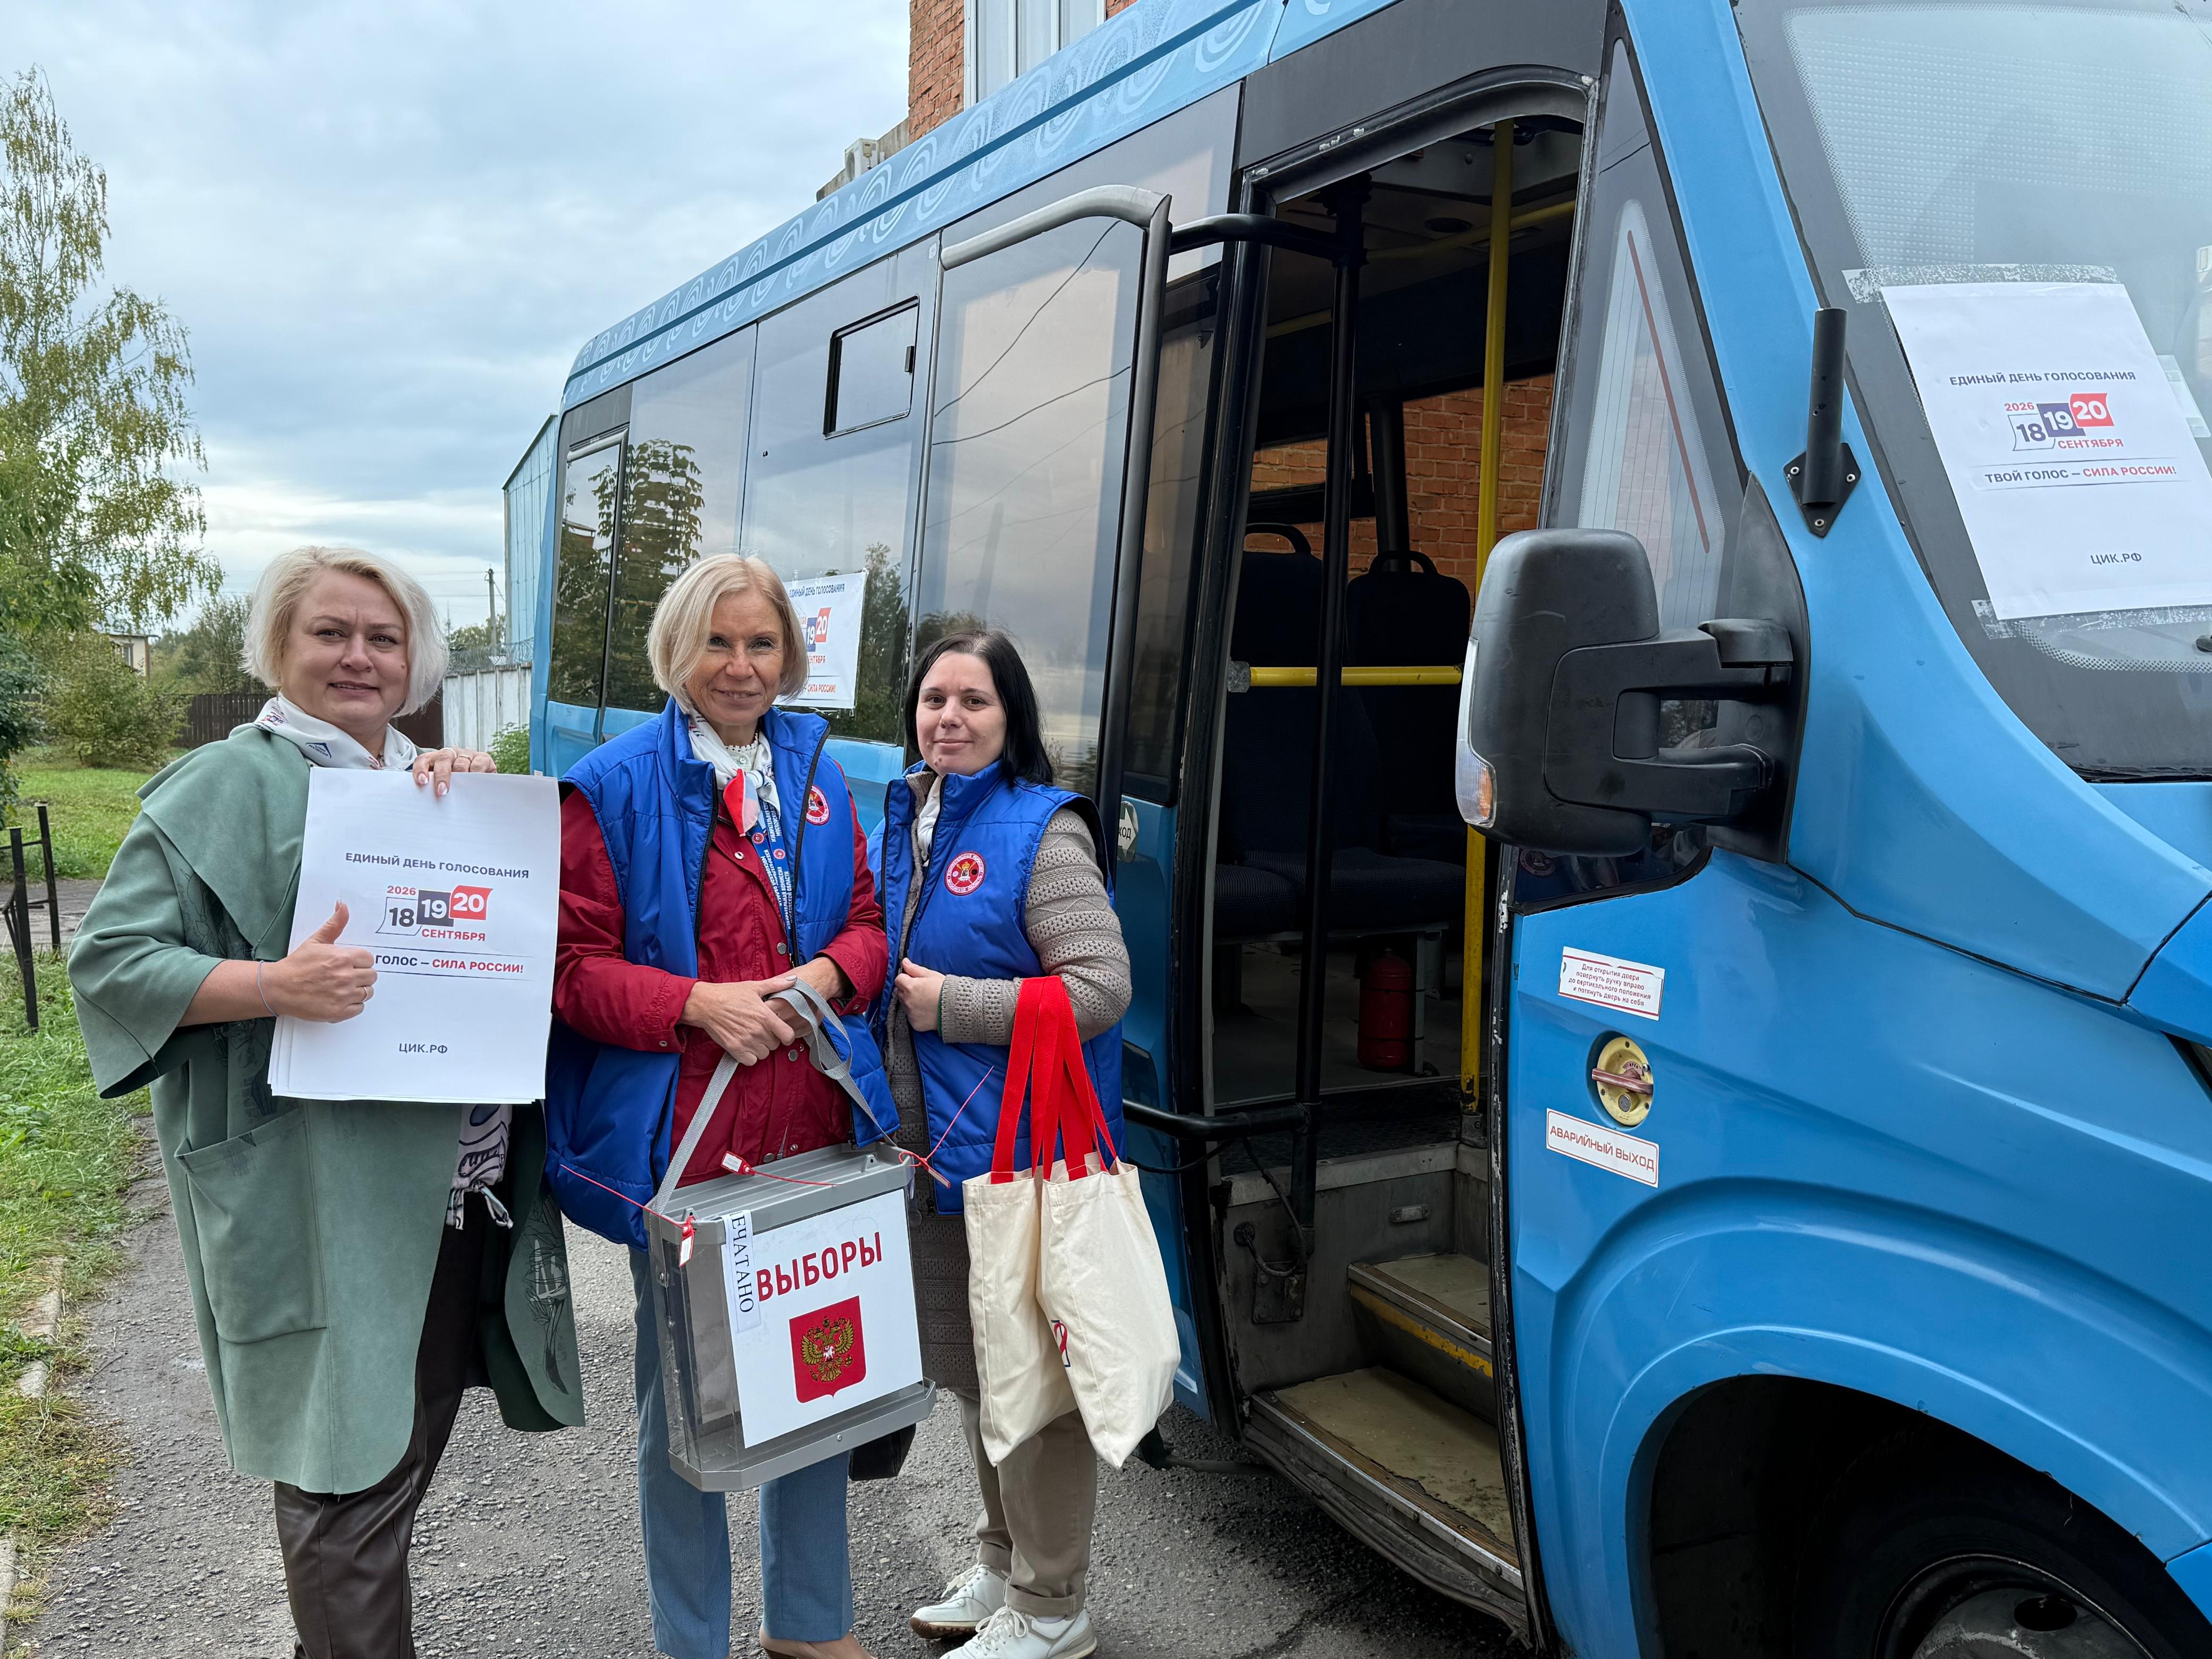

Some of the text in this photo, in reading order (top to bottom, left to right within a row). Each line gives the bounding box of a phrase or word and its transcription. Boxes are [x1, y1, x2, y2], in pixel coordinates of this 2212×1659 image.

[1949, 371, 2136, 386] ЕДИНЫЙ ДЕНЬ ГОЛОСОВАНИЯ
[2004, 401, 2034, 412] 2026
[2016, 400, 2107, 442] 18 19 20
[2058, 438, 2124, 449] СЕНТЯБРЯ
[1985, 470, 2022, 483] ТВОЙ
[2025, 469, 2068, 481] ГОЛОС
[2083, 467, 2119, 477] СИЛА
[2122, 465, 2177, 476] РОССИИ!
[2090, 552, 2142, 565] ЦИК.РФ
[816, 583, 844, 594] ГОЛОСОВАНИЯ
[807, 616, 827, 645] 19 20
[1119, 827, 1131, 840] ХОД
[346, 852, 529, 879] ЕДИНЫЙ ДЕНЬ ГОЛОСОВАНИЯ
[387, 885, 416, 896] 2026
[389, 892, 484, 927] 18 19 20
[422, 928, 485, 942] СЕНТЯБРЯ
[375, 955, 417, 967] ГОЛОС
[432, 959, 466, 970] СИЛА
[470, 962, 523, 973] РОССИИ!
[1595, 967, 1621, 977] открытия
[1606, 977, 1622, 986] ручку
[1577, 979, 1618, 992] вертикального
[1619, 988, 1651, 1000] положения
[1578, 987, 1603, 997] потянуть
[1604, 993, 1621, 1001] дверь
[1630, 998, 1644, 1007] себя
[399, 1043, 448, 1054] ЦИК.РФ
[1550, 1125, 1654, 1172] АВАРИЙНЫЙ ВЫХОД
[757, 1231, 882, 1302] ВЫБОРЫ
